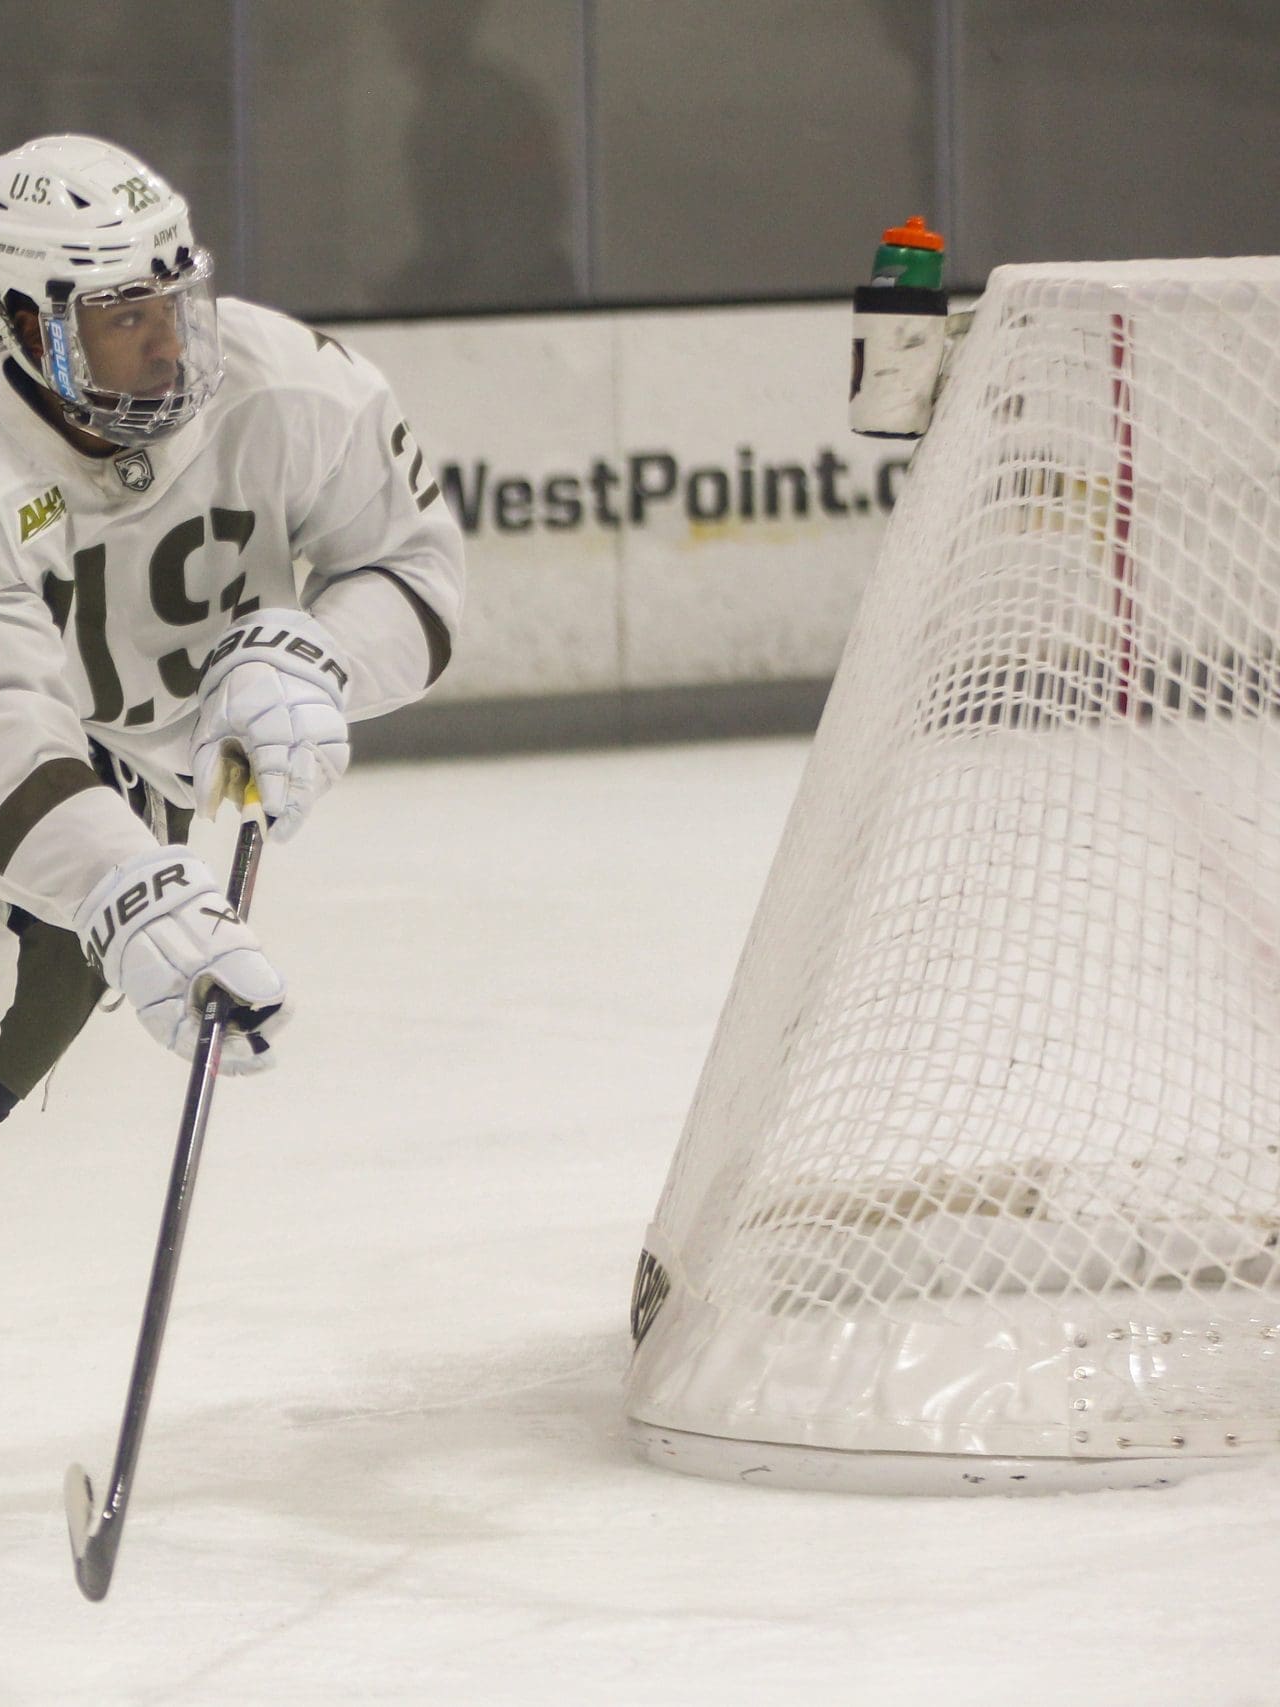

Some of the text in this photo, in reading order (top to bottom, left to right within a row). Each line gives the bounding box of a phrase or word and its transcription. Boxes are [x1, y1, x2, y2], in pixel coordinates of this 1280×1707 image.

[9, 173, 52, 206] U.S.
[112, 176, 161, 214] 28
[153, 224, 179, 248] ARMY
